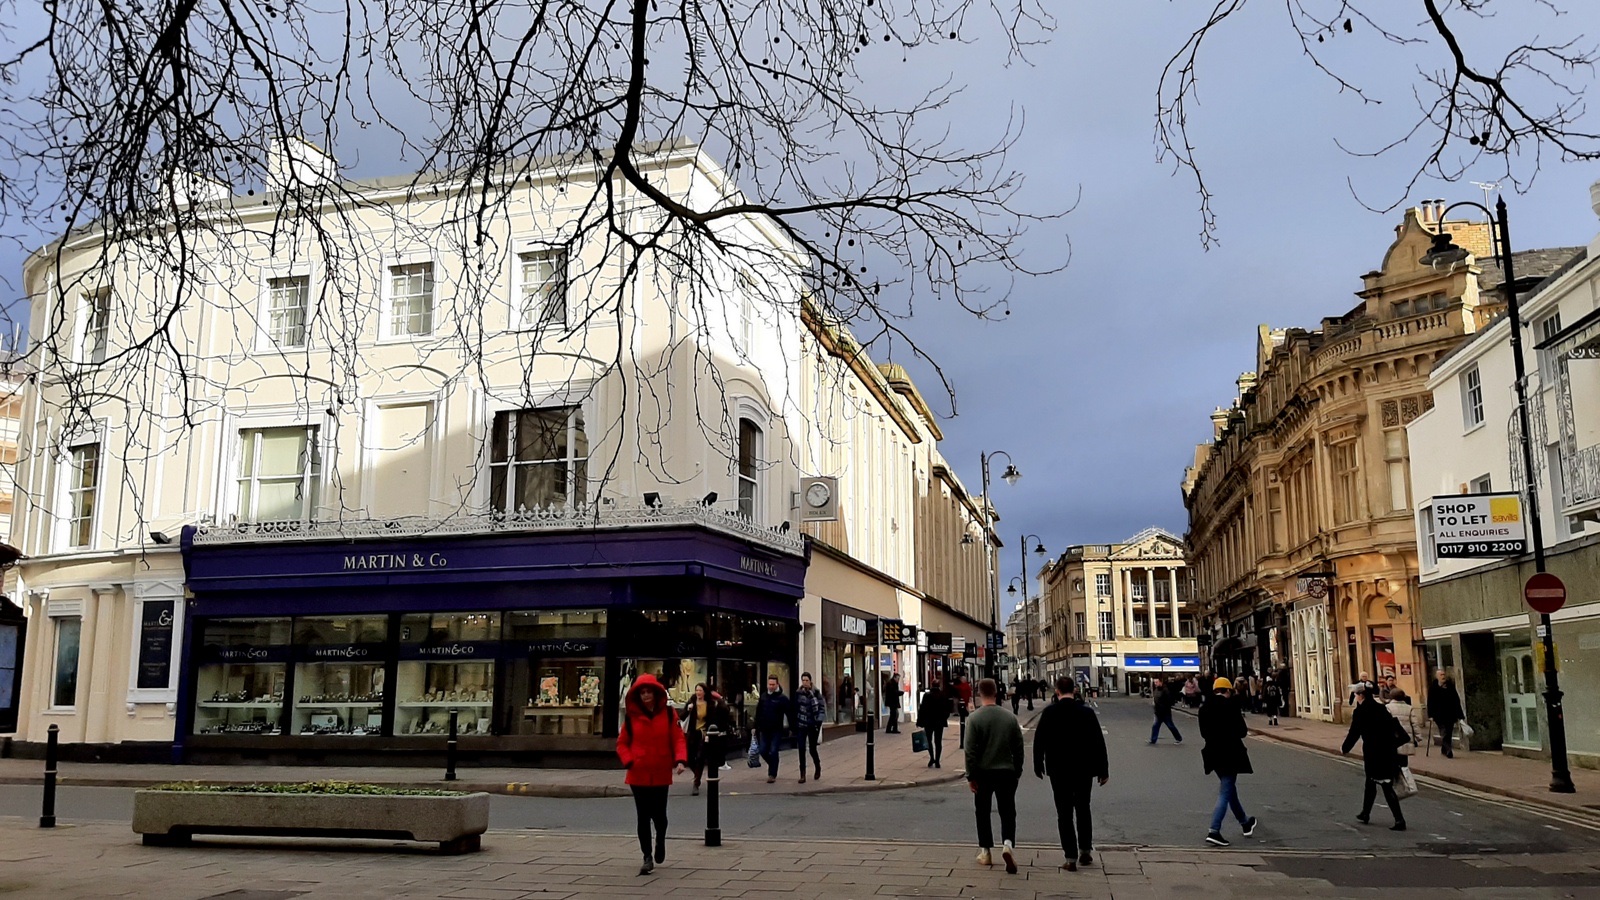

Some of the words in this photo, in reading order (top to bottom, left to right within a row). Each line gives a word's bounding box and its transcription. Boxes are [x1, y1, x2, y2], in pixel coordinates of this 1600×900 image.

[1437, 504, 1476, 514] SHOP
[1438, 516, 1458, 526] TO
[1462, 515, 1488, 524] LET
[1459, 528, 1510, 538] ENQUIRIES
[1440, 544, 1464, 554] 0117
[1468, 544, 1488, 552] 910
[1492, 542, 1522, 552] 2200
[344, 554, 406, 570] MARTIN
[412, 554, 425, 566] &
[430, 553, 446, 566] Co
[740, 556, 764, 572] MARTIN
